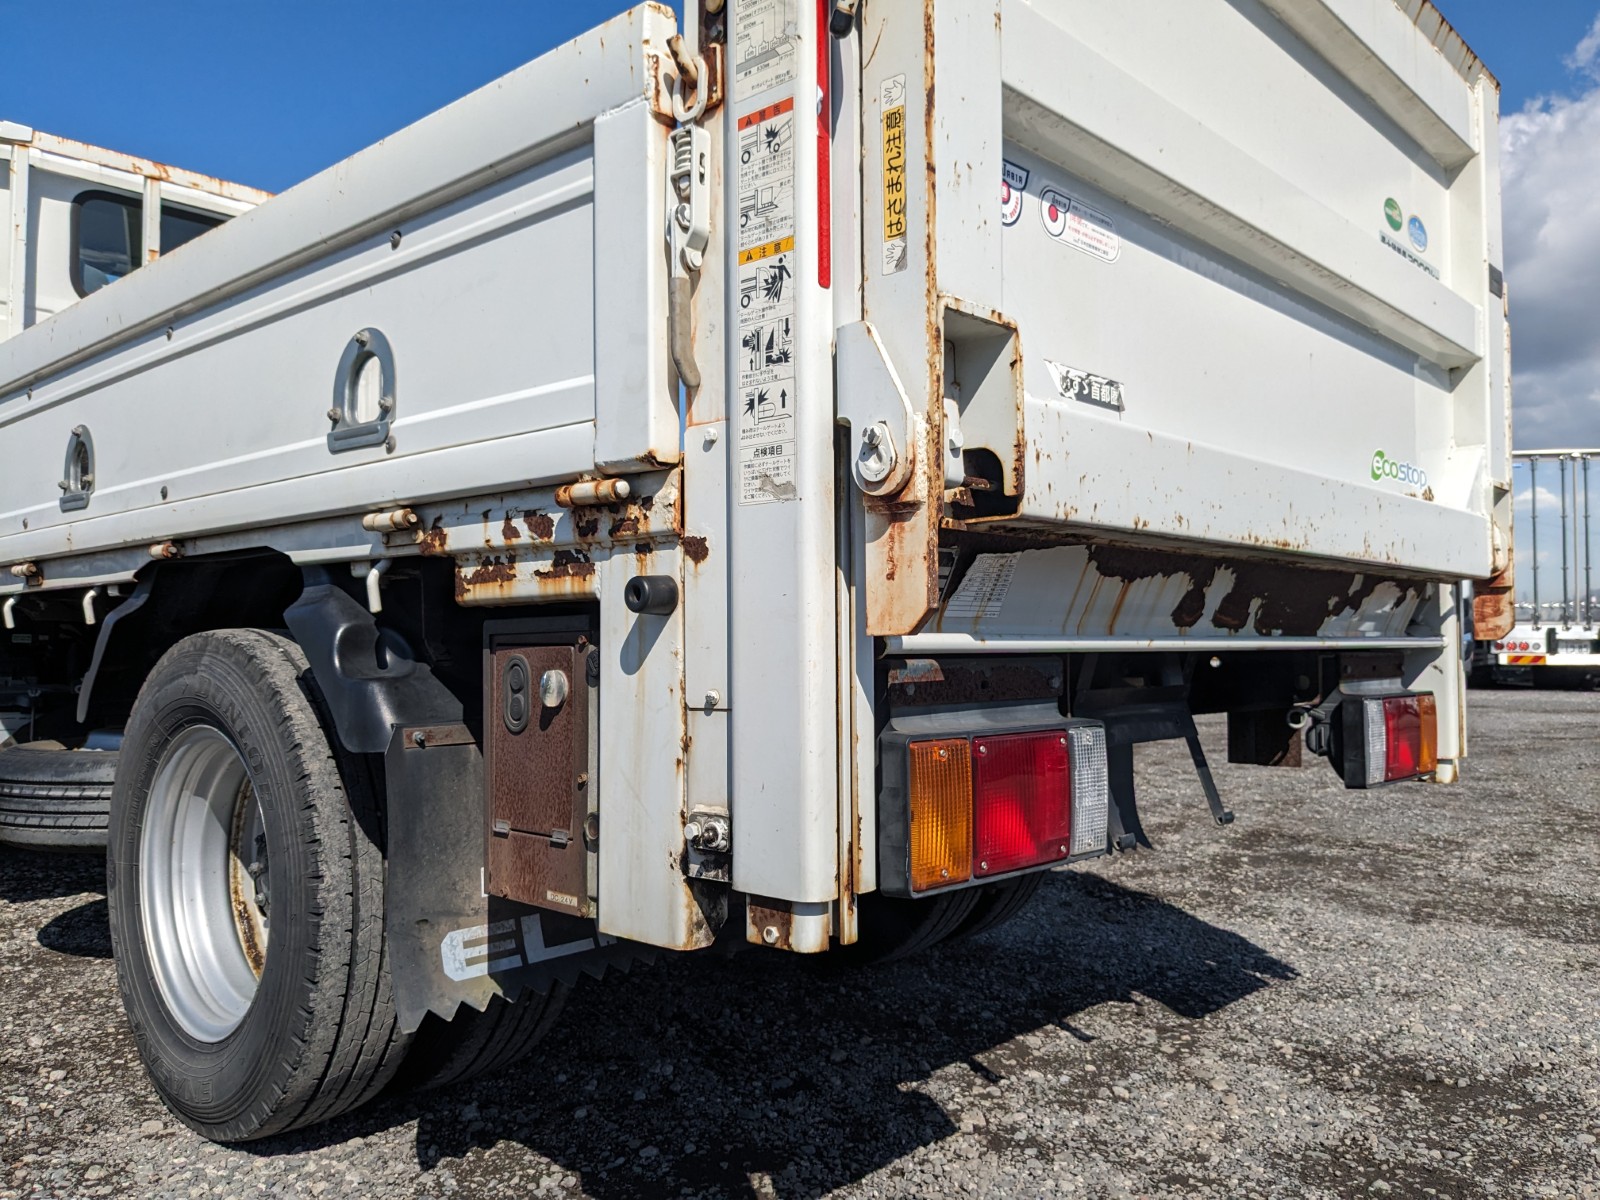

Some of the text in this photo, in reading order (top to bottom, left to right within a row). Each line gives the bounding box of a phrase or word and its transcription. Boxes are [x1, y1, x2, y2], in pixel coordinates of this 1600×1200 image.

[885, 109, 904, 238] はさまれ注意
[760, 242, 781, 258] 注意
[753, 445, 782, 458] 点検項目
[1371, 450, 1427, 489] ecostop
